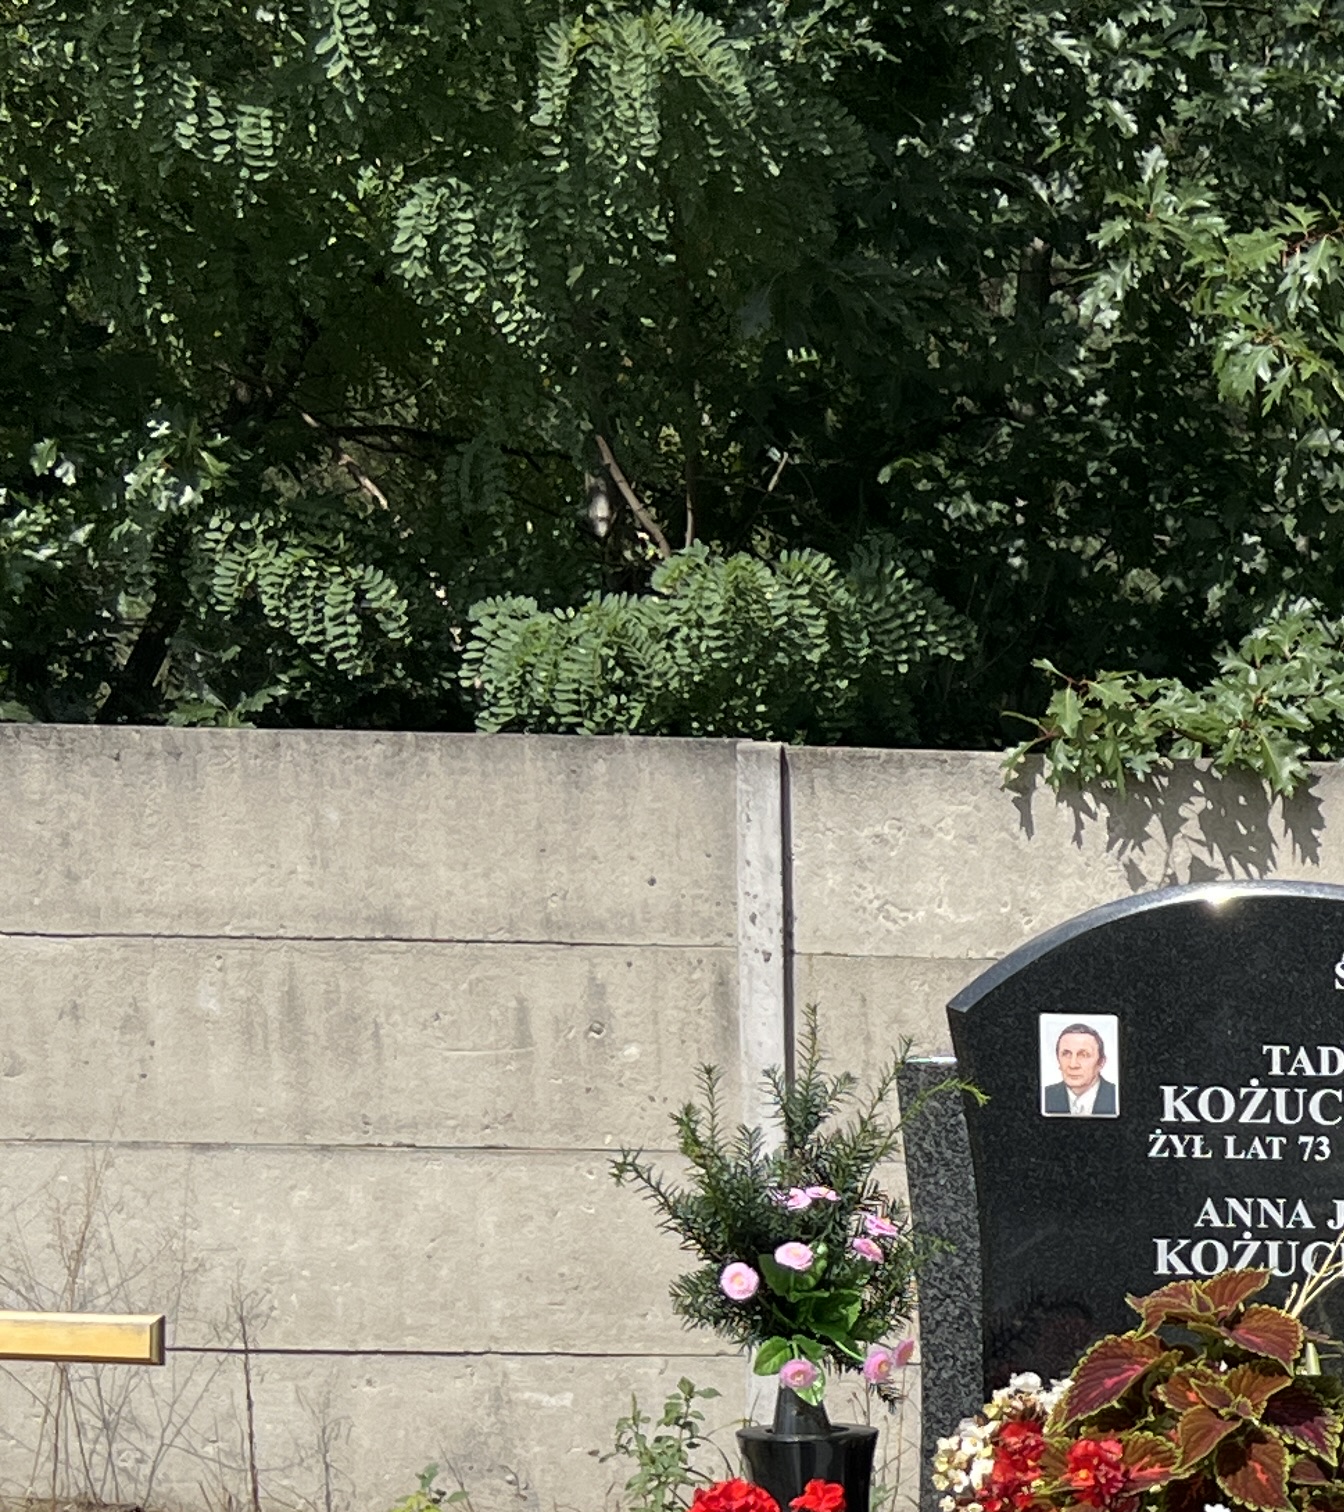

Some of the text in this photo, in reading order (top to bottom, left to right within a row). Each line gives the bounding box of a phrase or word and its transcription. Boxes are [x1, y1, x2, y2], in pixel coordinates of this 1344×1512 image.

[1147, 1128, 1212, 1159] ŻYŁ
[1225, 1136, 1287, 1160] LAT
[1299, 1135, 1331, 1161] 73
[1194, 1197, 1317, 1230] ANNA
